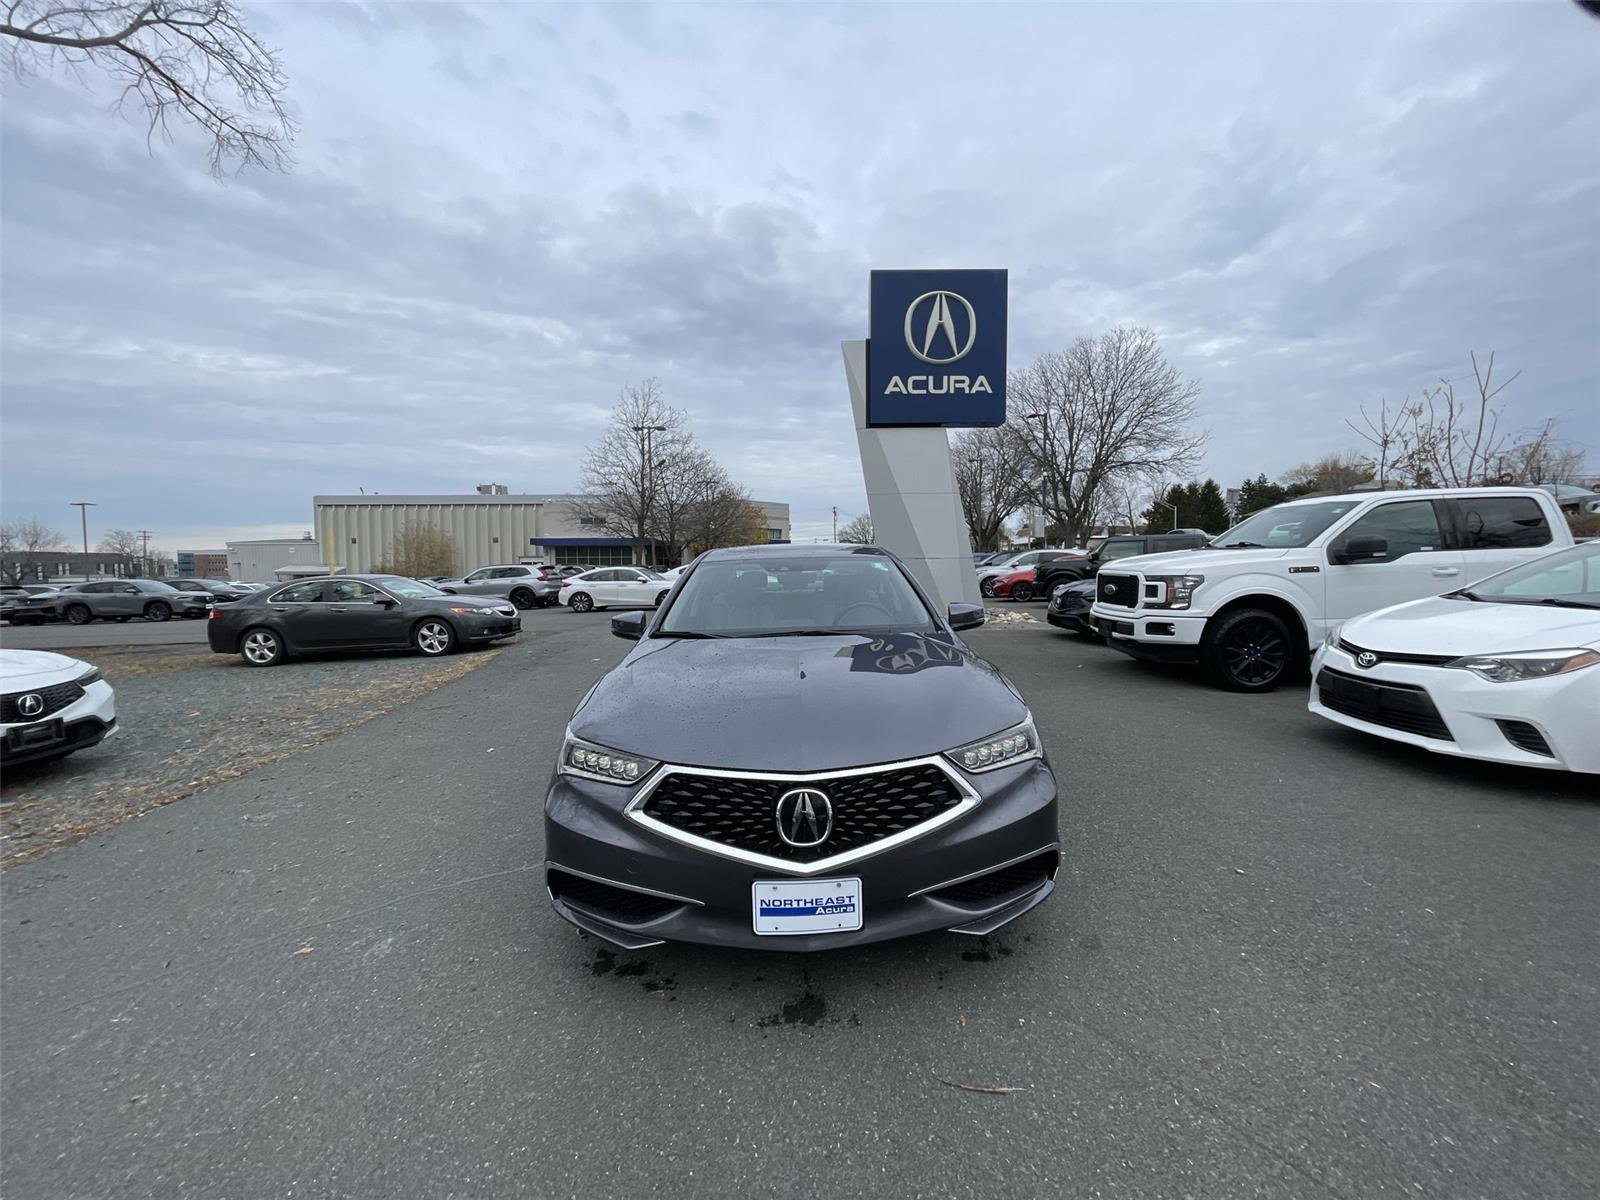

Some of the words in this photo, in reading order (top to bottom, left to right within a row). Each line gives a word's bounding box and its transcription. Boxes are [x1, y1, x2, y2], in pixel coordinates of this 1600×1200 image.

[884, 375, 993, 395] ACURA
[760, 895, 855, 908] NORTHEAST
[815, 906, 854, 915] Acura
